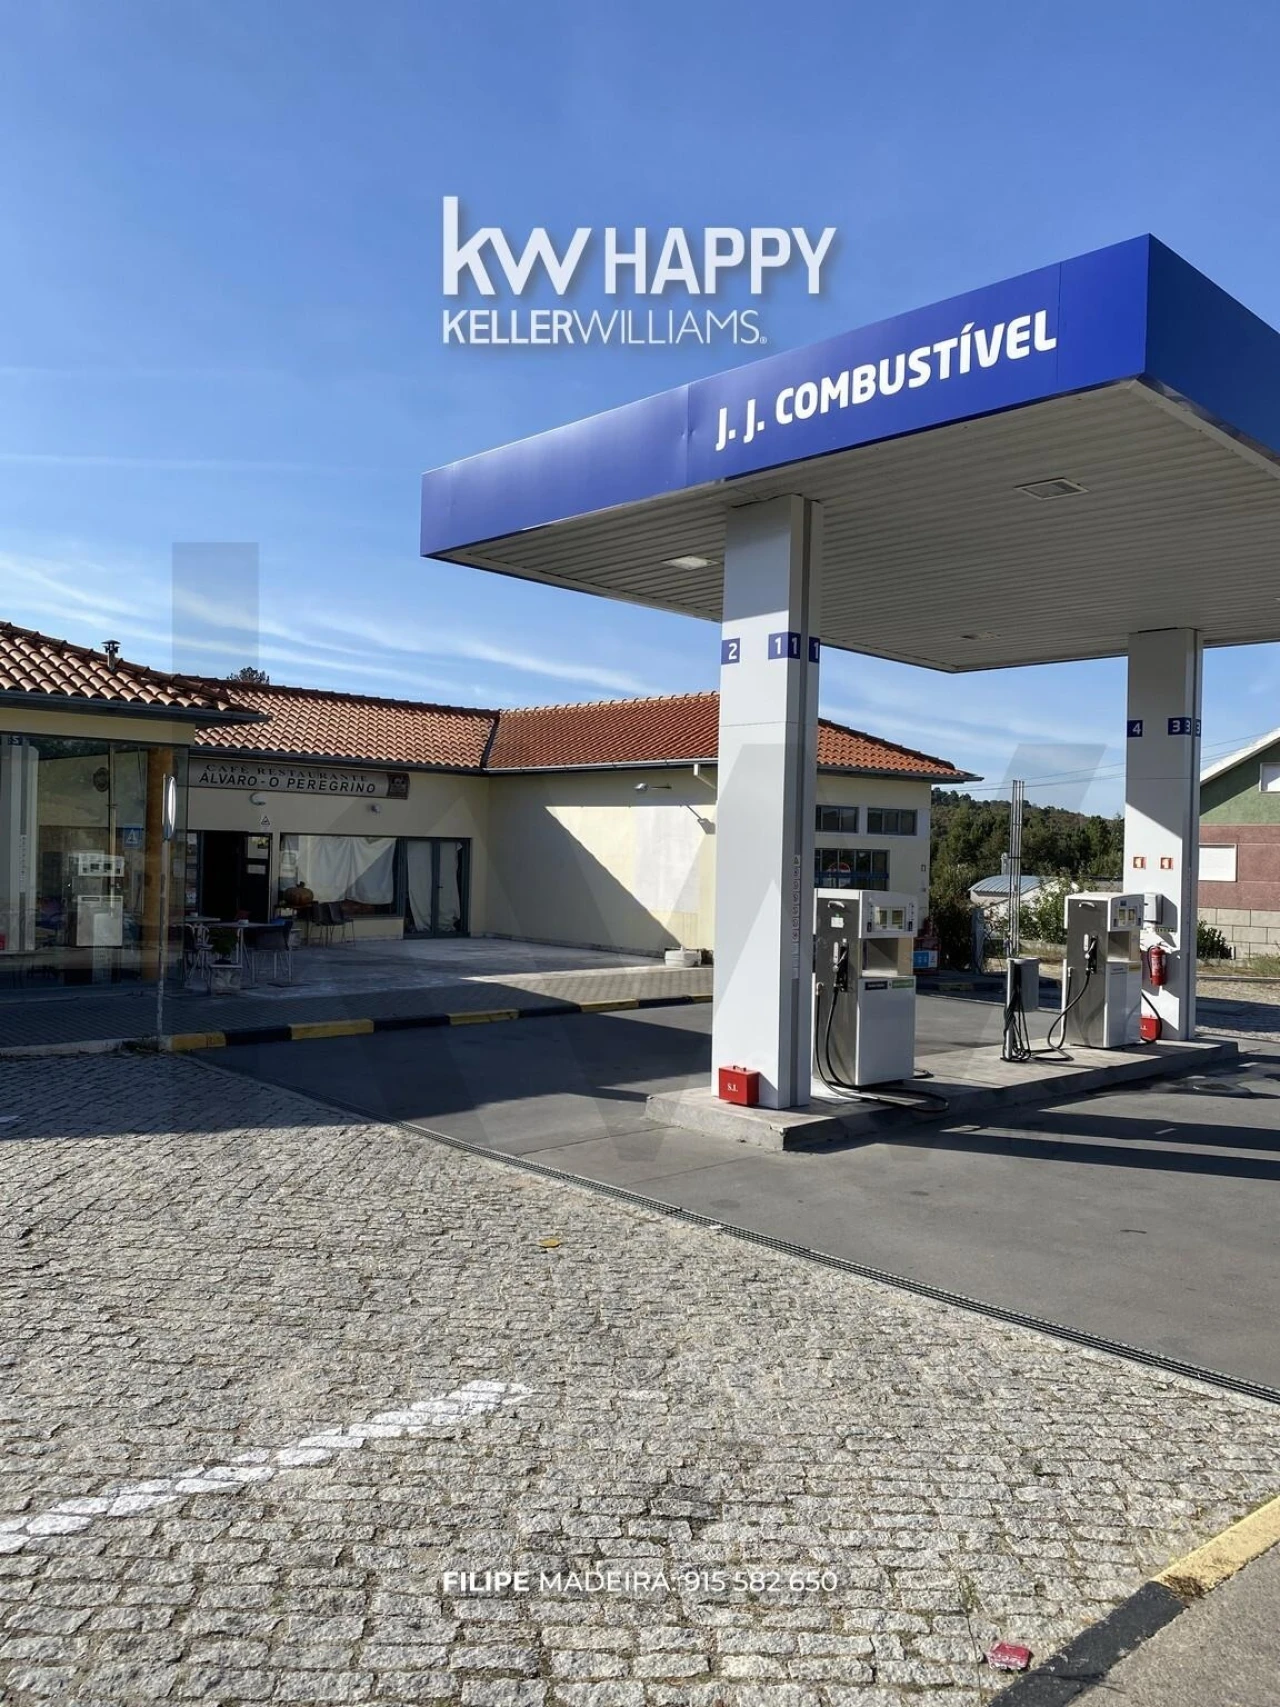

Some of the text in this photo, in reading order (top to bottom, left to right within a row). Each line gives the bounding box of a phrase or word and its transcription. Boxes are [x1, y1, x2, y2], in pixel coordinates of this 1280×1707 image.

[715, 309, 1057, 451] J. J. COMBUSTÍVEL
[728, 642, 738, 660] 2
[774, 637, 782, 654] 1
[791, 637, 798, 655] 1
[813, 641, 819, 659] 1
[1132, 722, 1142, 735] 4
[1172, 720, 1181, 732] 3
[257, 767, 369, 782] RESTAURANTE
[287, 777, 376, 793] PEREGRINO
